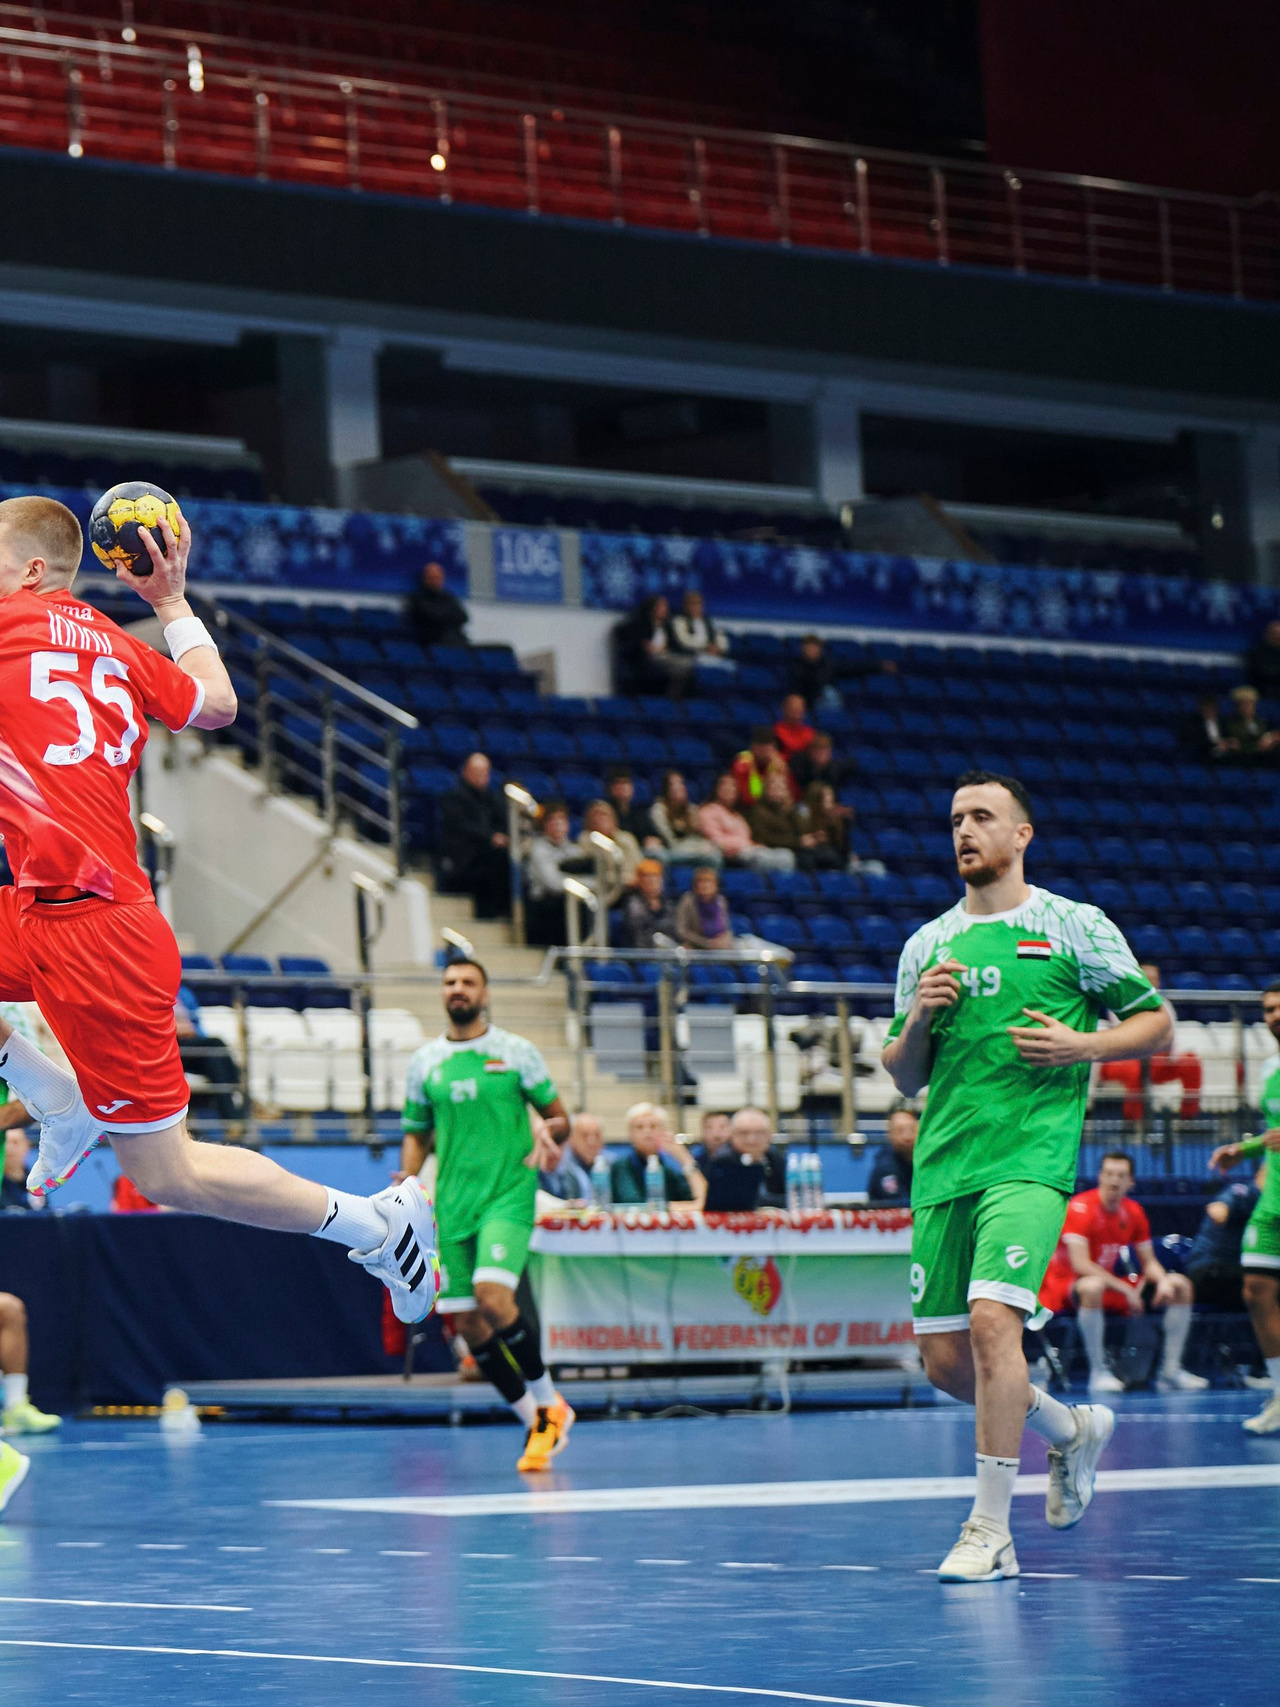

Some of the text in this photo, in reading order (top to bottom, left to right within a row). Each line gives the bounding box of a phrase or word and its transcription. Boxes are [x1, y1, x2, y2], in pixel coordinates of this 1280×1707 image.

[30, 650, 141, 768] 55
[961, 965, 1002, 998] 49
[549, 1324, 663, 1350] HANDBALL
[673, 1323, 808, 1350] FEDERATION
[814, 1322, 842, 1348] OF
